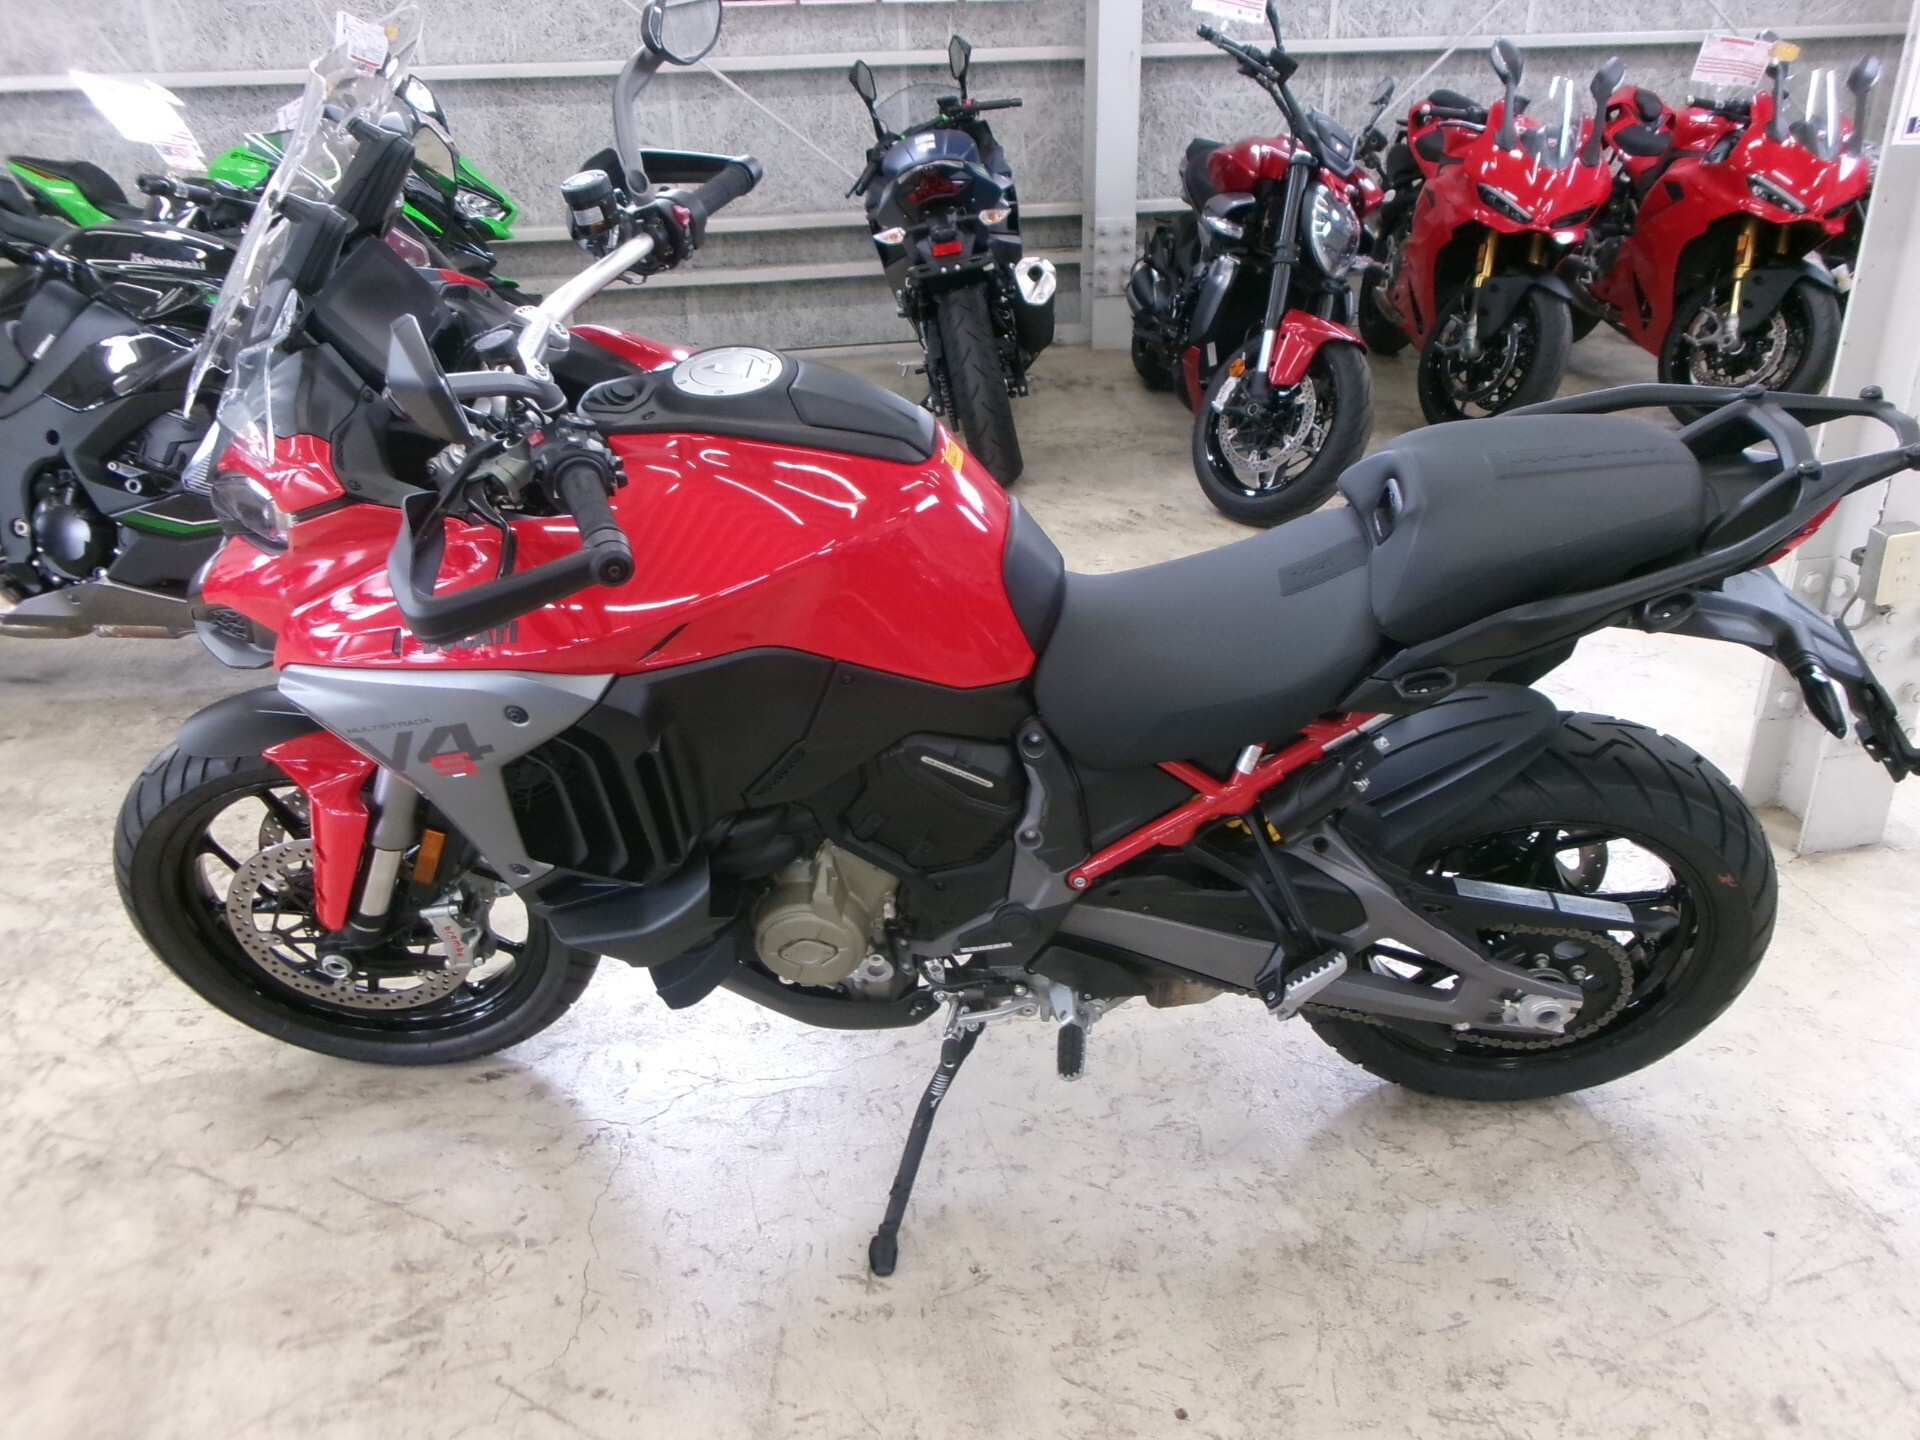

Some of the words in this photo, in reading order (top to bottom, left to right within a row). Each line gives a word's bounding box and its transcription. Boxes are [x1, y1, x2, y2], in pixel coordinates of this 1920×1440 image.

[346, 717, 432, 734] MULTISTRADA
[349, 722, 495, 774] V4
[429, 751, 479, 777] S
[444, 925, 464, 957] brembo
